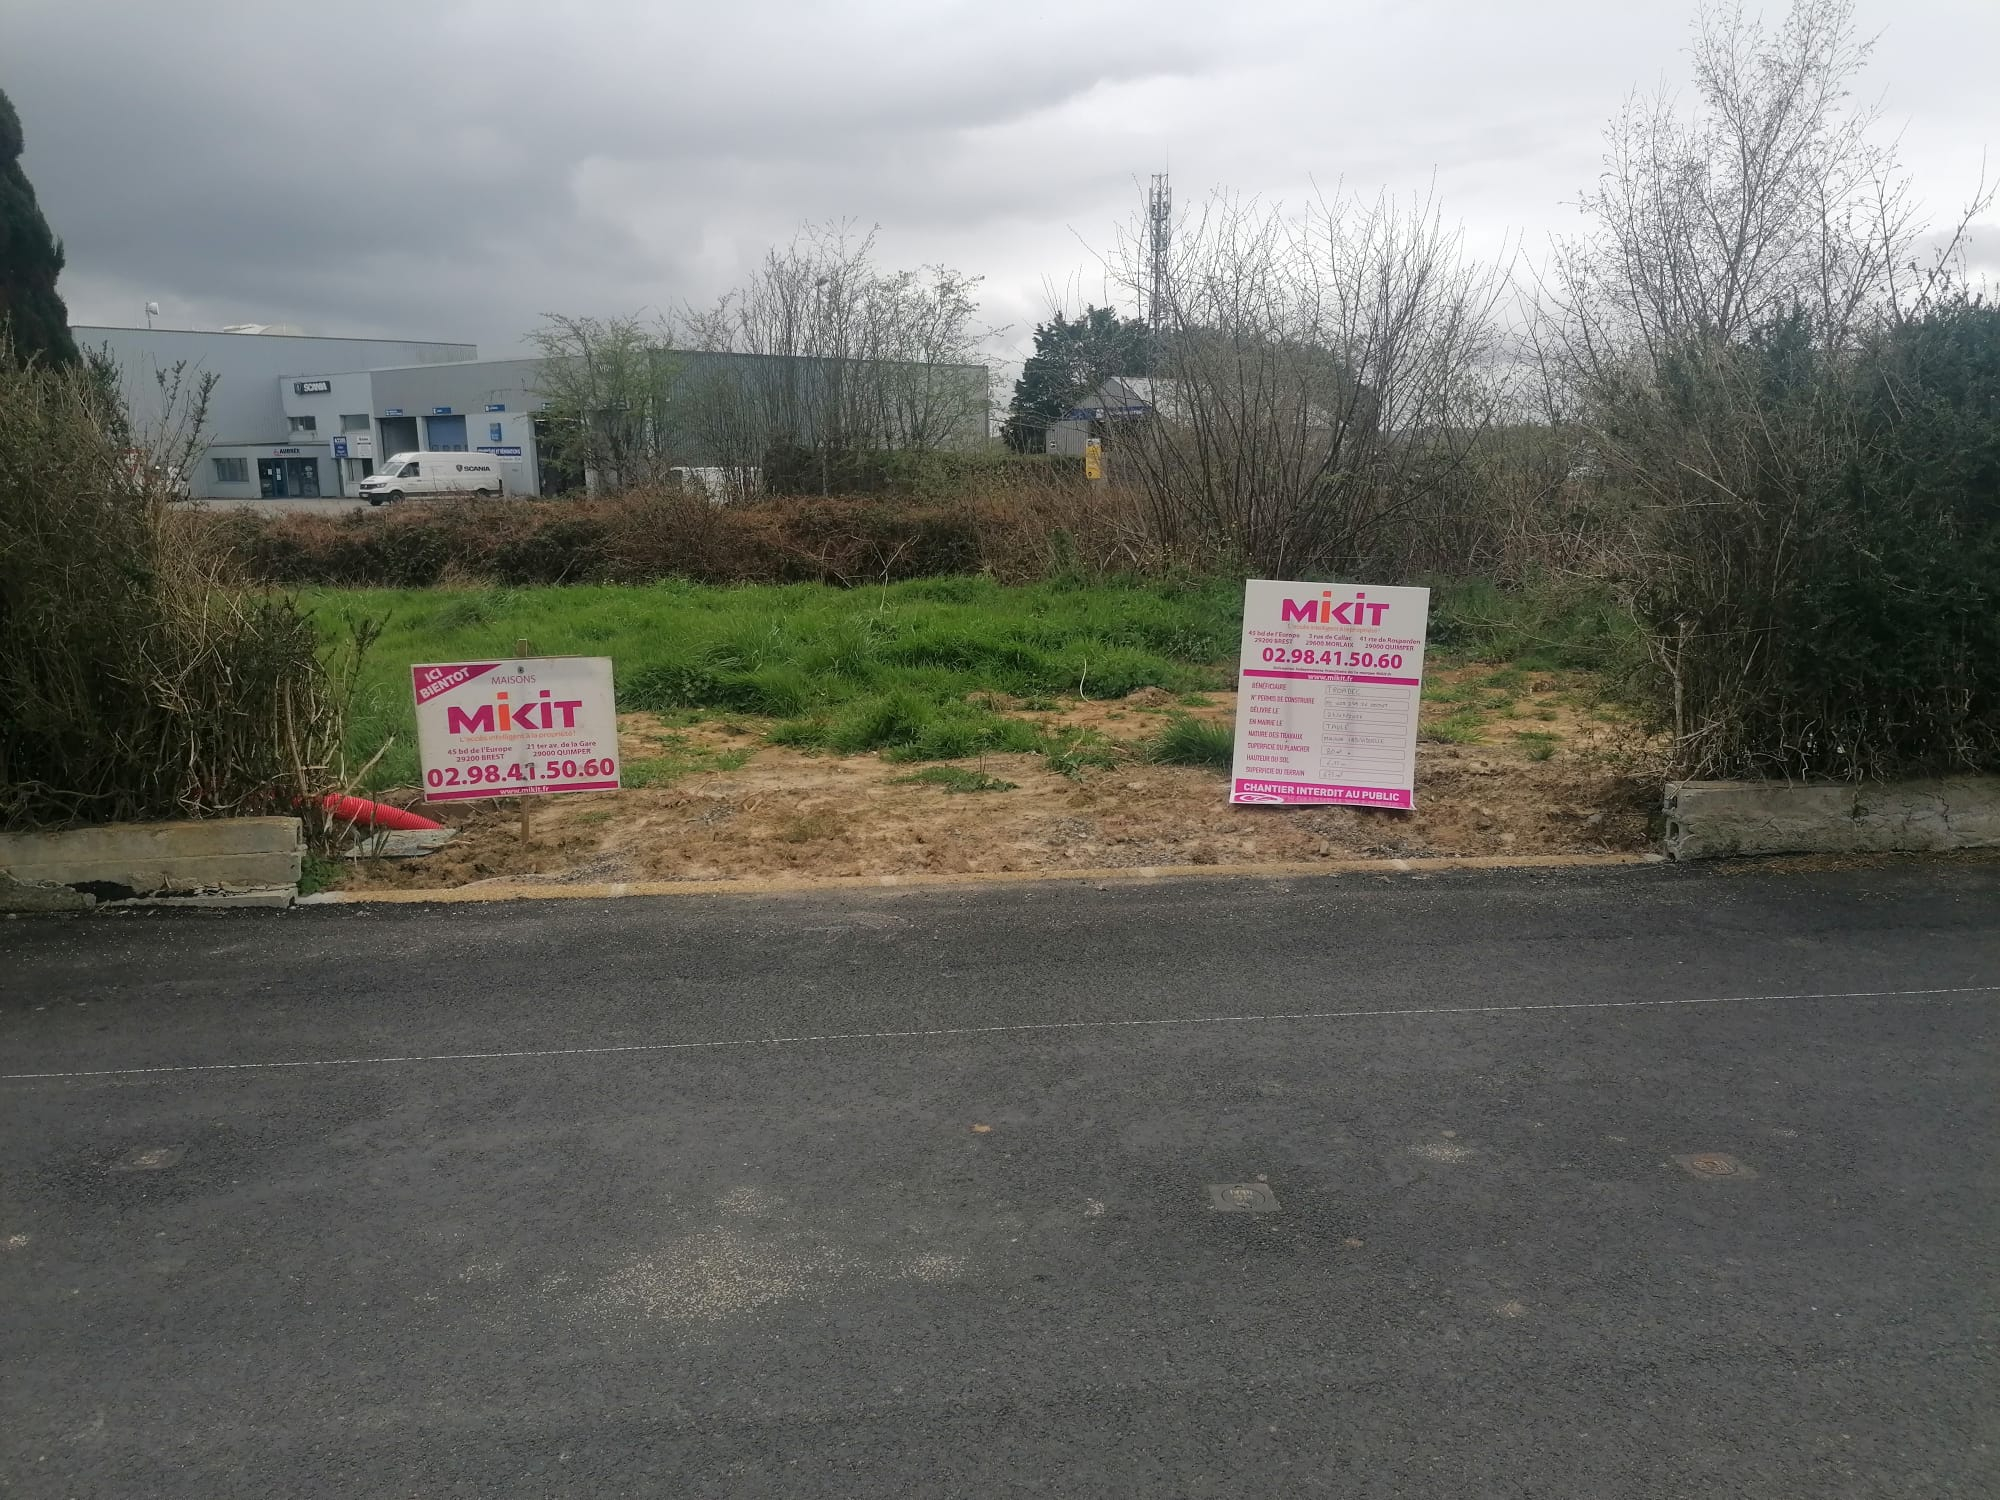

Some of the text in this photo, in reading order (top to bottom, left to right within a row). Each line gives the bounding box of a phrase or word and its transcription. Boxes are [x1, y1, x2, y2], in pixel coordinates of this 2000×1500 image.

[1262, 647, 1403, 669] 02.98.41.50.60
[424, 668, 443, 683] ICI
[491, 675, 536, 685] MAISONS
[1307, 674, 1353, 682] www.mikit.fr
[419, 667, 470, 699] BIENTOT
[1248, 730, 1268, 738] NATURE
[1280, 732, 1303, 740] TRAVAUX
[578, 739, 597, 748] Gare
[1247, 742, 1276, 750] SUPERFICIE
[470, 746, 481, 754] de
[481, 745, 512, 754] l'Europe
[556, 748, 592, 756] QUIMPER
[481, 753, 505, 761] BREST
[1246, 754, 1289, 764] HAUTEUR DU SOL
[427, 758, 615, 788] 02.98.41.50.60
[1245, 766, 1275, 774] SUPERFICIE
[499, 785, 550, 795] www.mikit.fr
[1243, 783, 1294, 794] CHANTIER
[1296, 787, 1344, 798] INTERDIT
[1345, 790, 1360, 799] AU
[1361, 791, 1400, 801] PUBLIC
